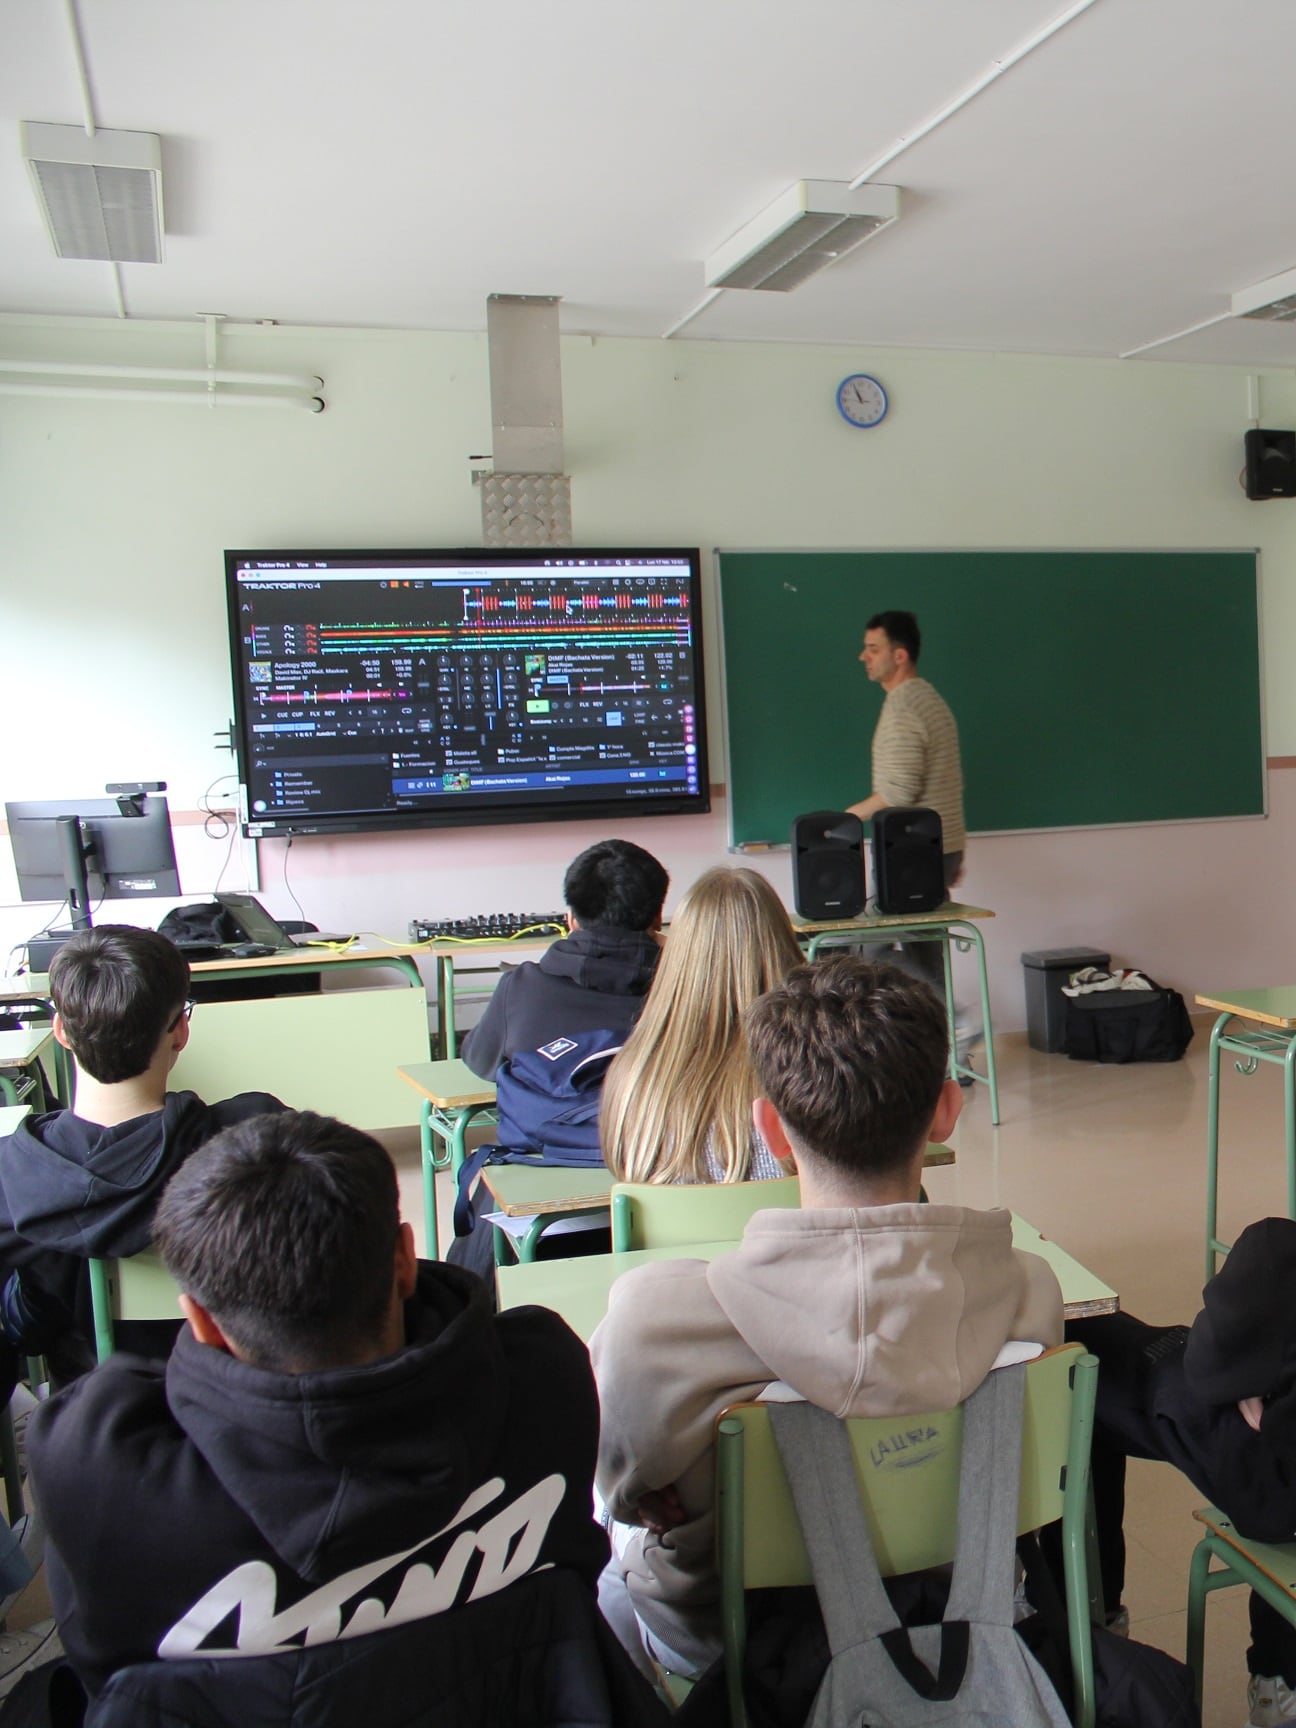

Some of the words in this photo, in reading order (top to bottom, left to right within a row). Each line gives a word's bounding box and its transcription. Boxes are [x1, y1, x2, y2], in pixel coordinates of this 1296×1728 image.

[243, 582, 297, 590] TRAKTOR
[297, 582, 313, 590] Pro
[274, 661, 300, 670] Apology
[418, 658, 426, 666] A
[869, 1424, 940, 1467] LAURA
